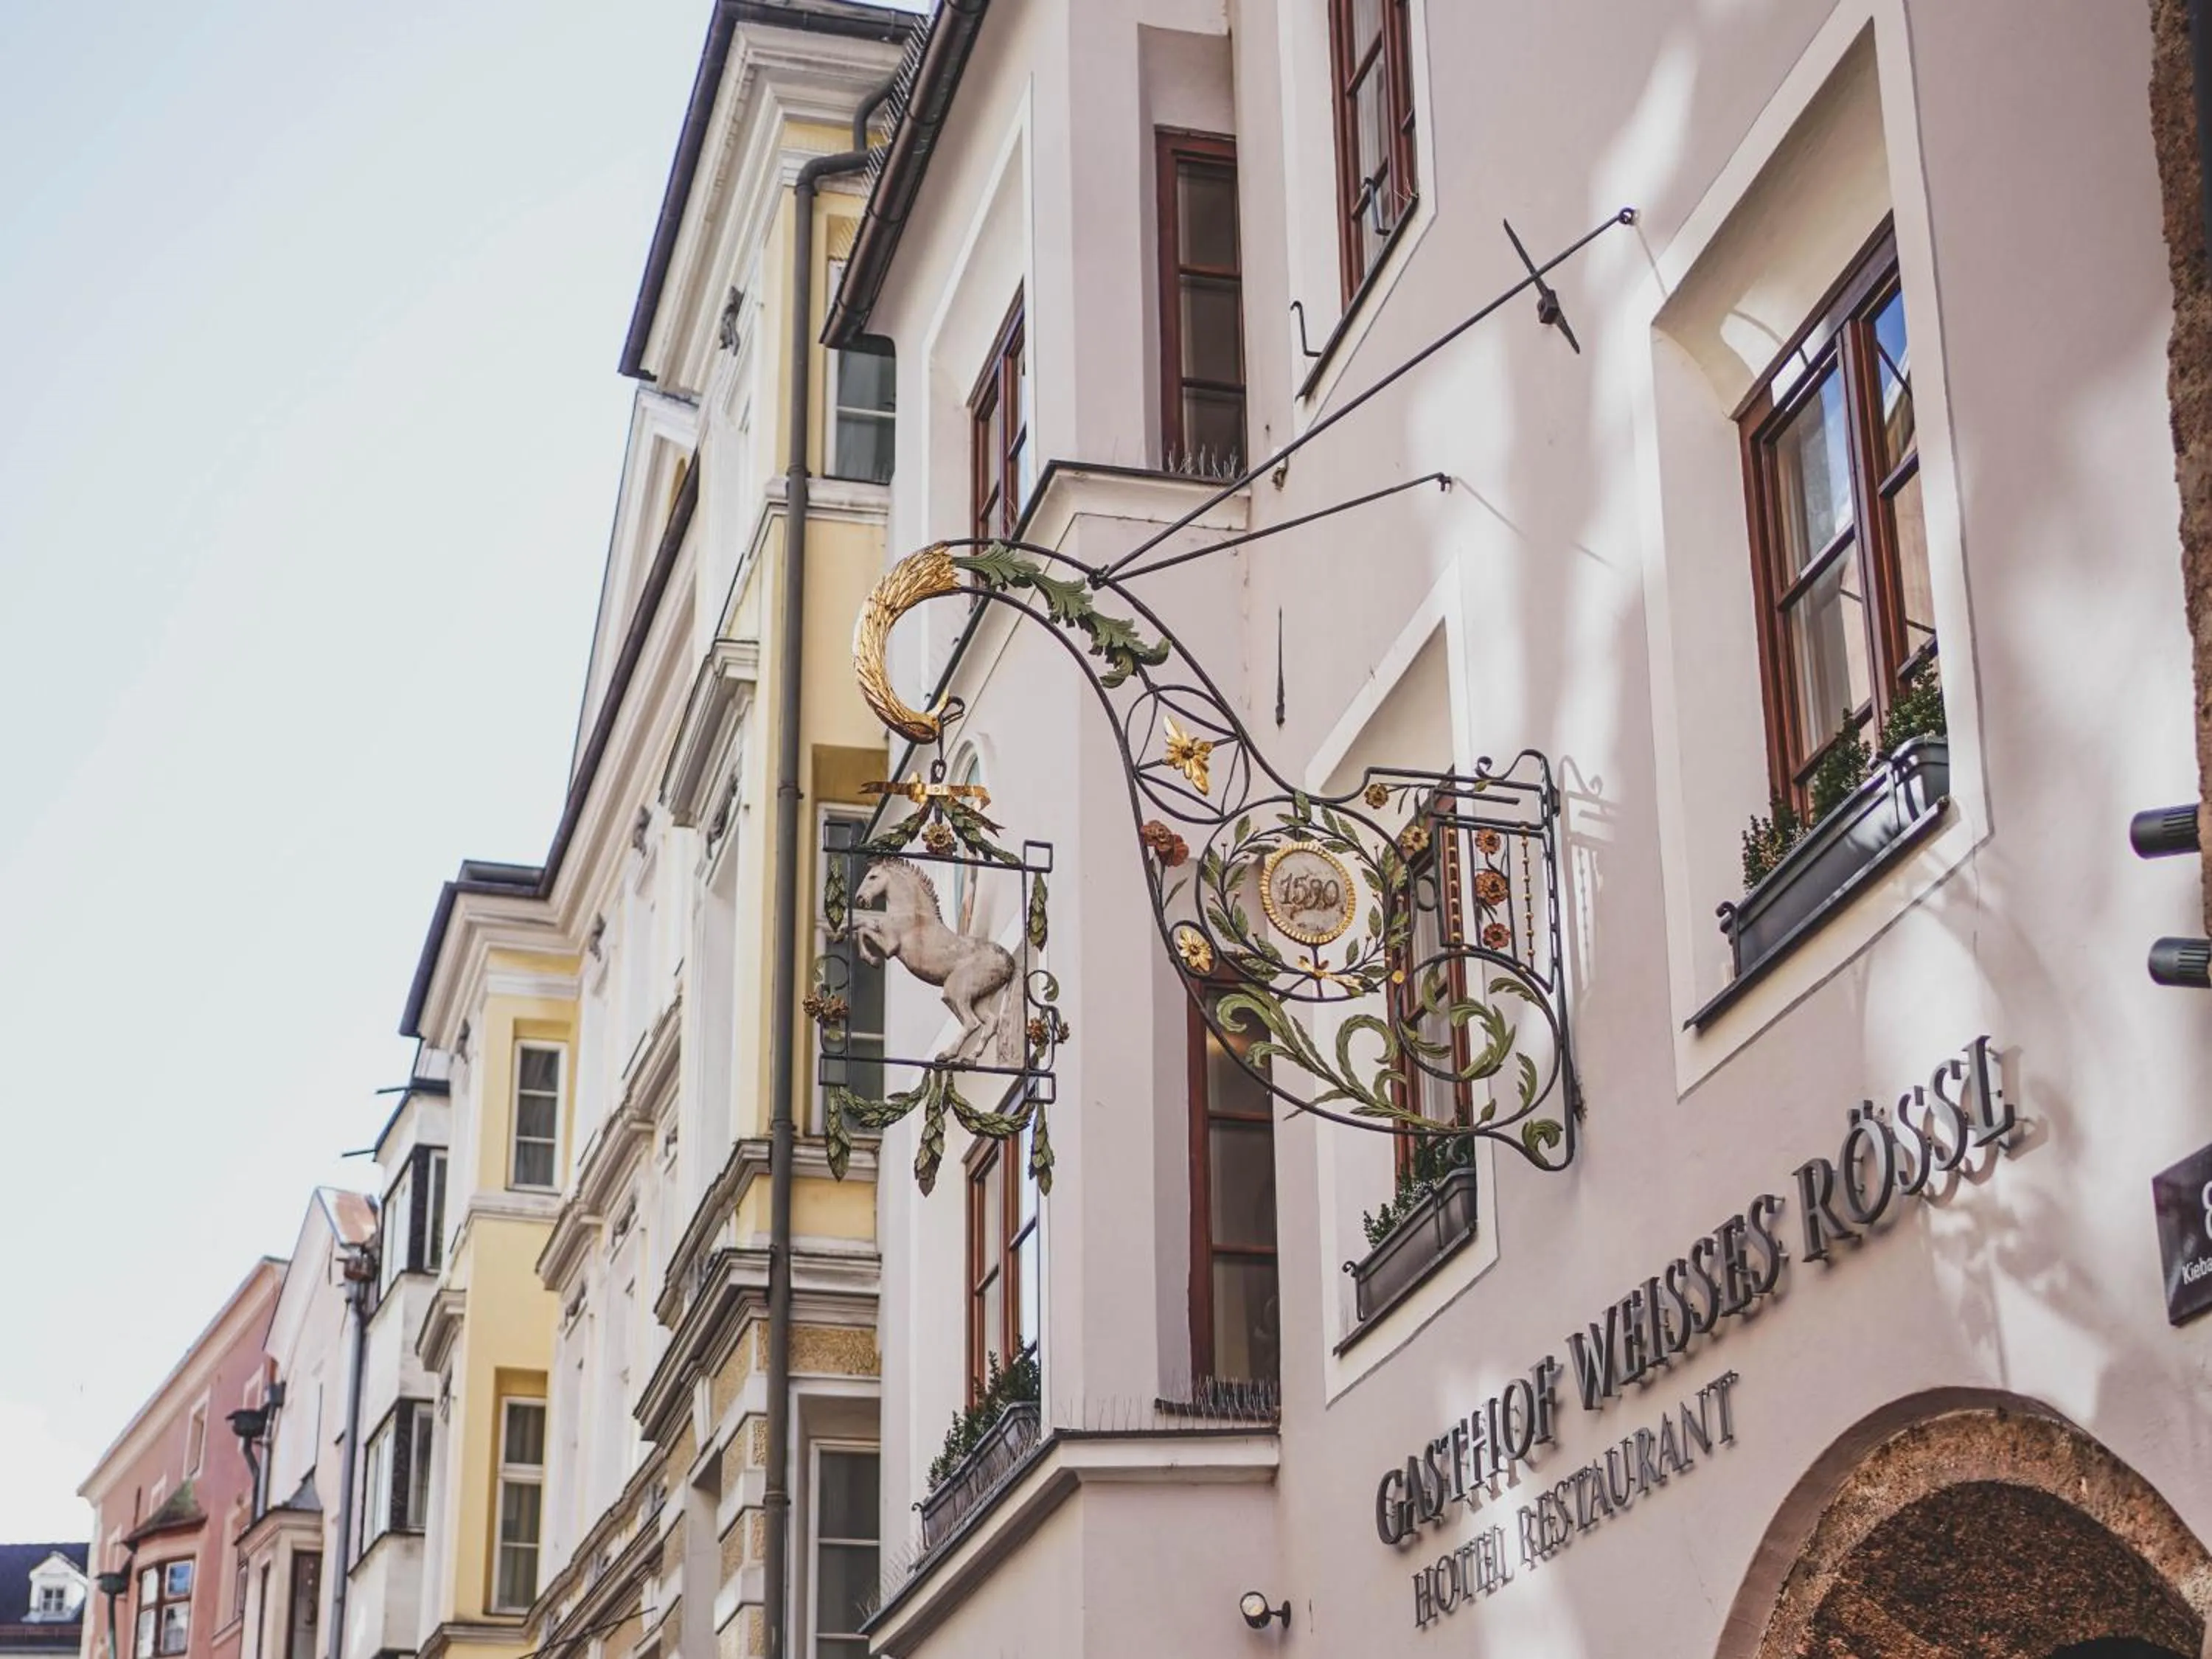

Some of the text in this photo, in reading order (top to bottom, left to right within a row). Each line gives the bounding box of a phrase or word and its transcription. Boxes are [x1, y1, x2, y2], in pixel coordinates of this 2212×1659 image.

[1280, 872, 1340, 911] 1590
[1376, 1036, 2015, 1545] GASTHOF WEISSES RÖSSL
[1412, 1370, 1739, 1629] HOTEL RESTAURANT
